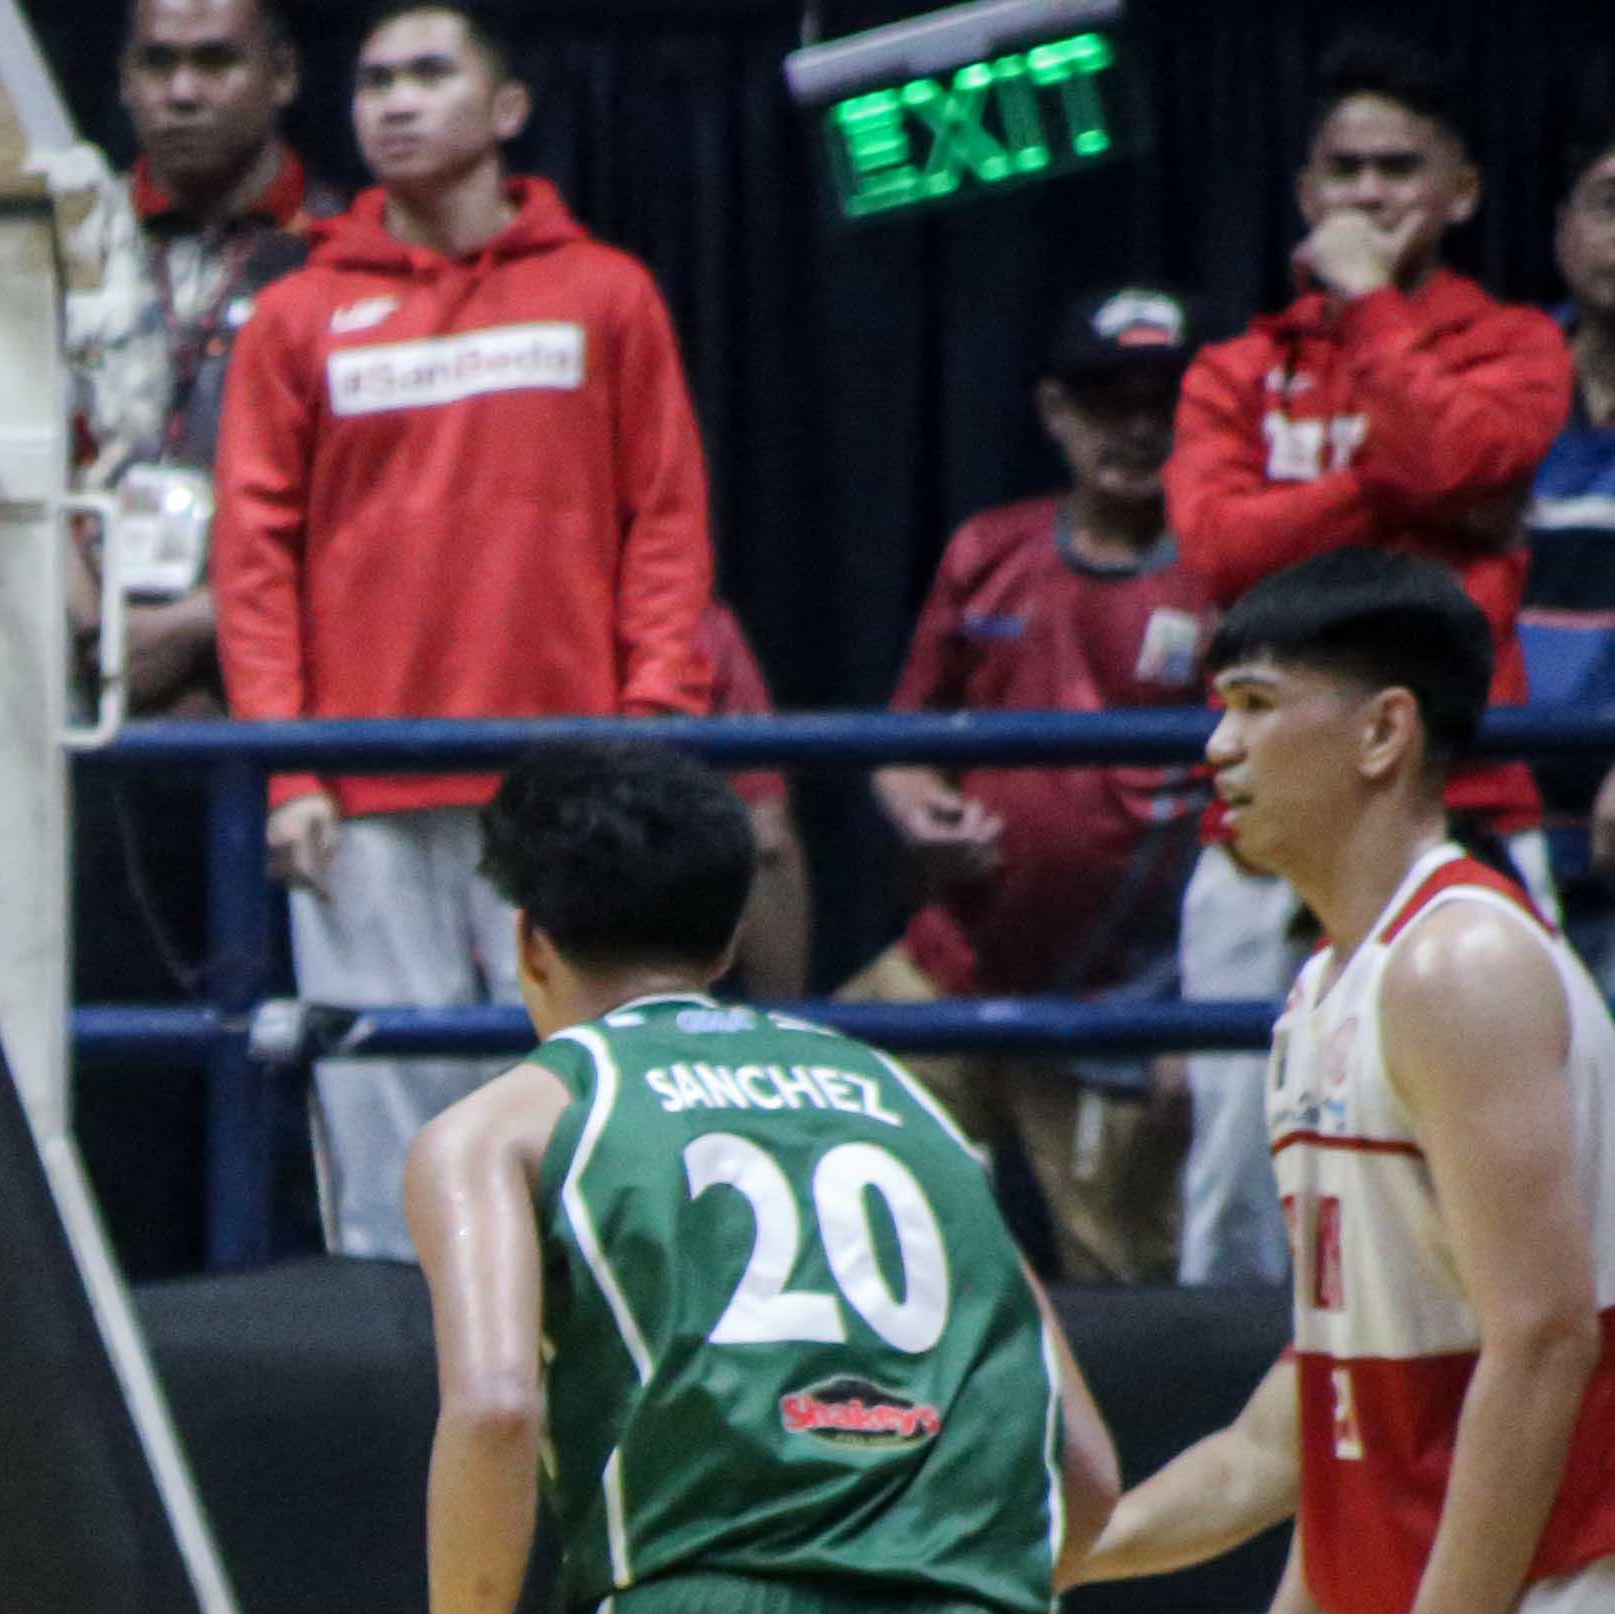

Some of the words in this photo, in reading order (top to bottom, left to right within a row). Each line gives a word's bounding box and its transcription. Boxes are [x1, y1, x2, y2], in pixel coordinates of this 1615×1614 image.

[834, 32, 1111, 218] EXIT
[645, 1062, 903, 1129] SANCHEZ
[682, 1132, 949, 1355] 20
